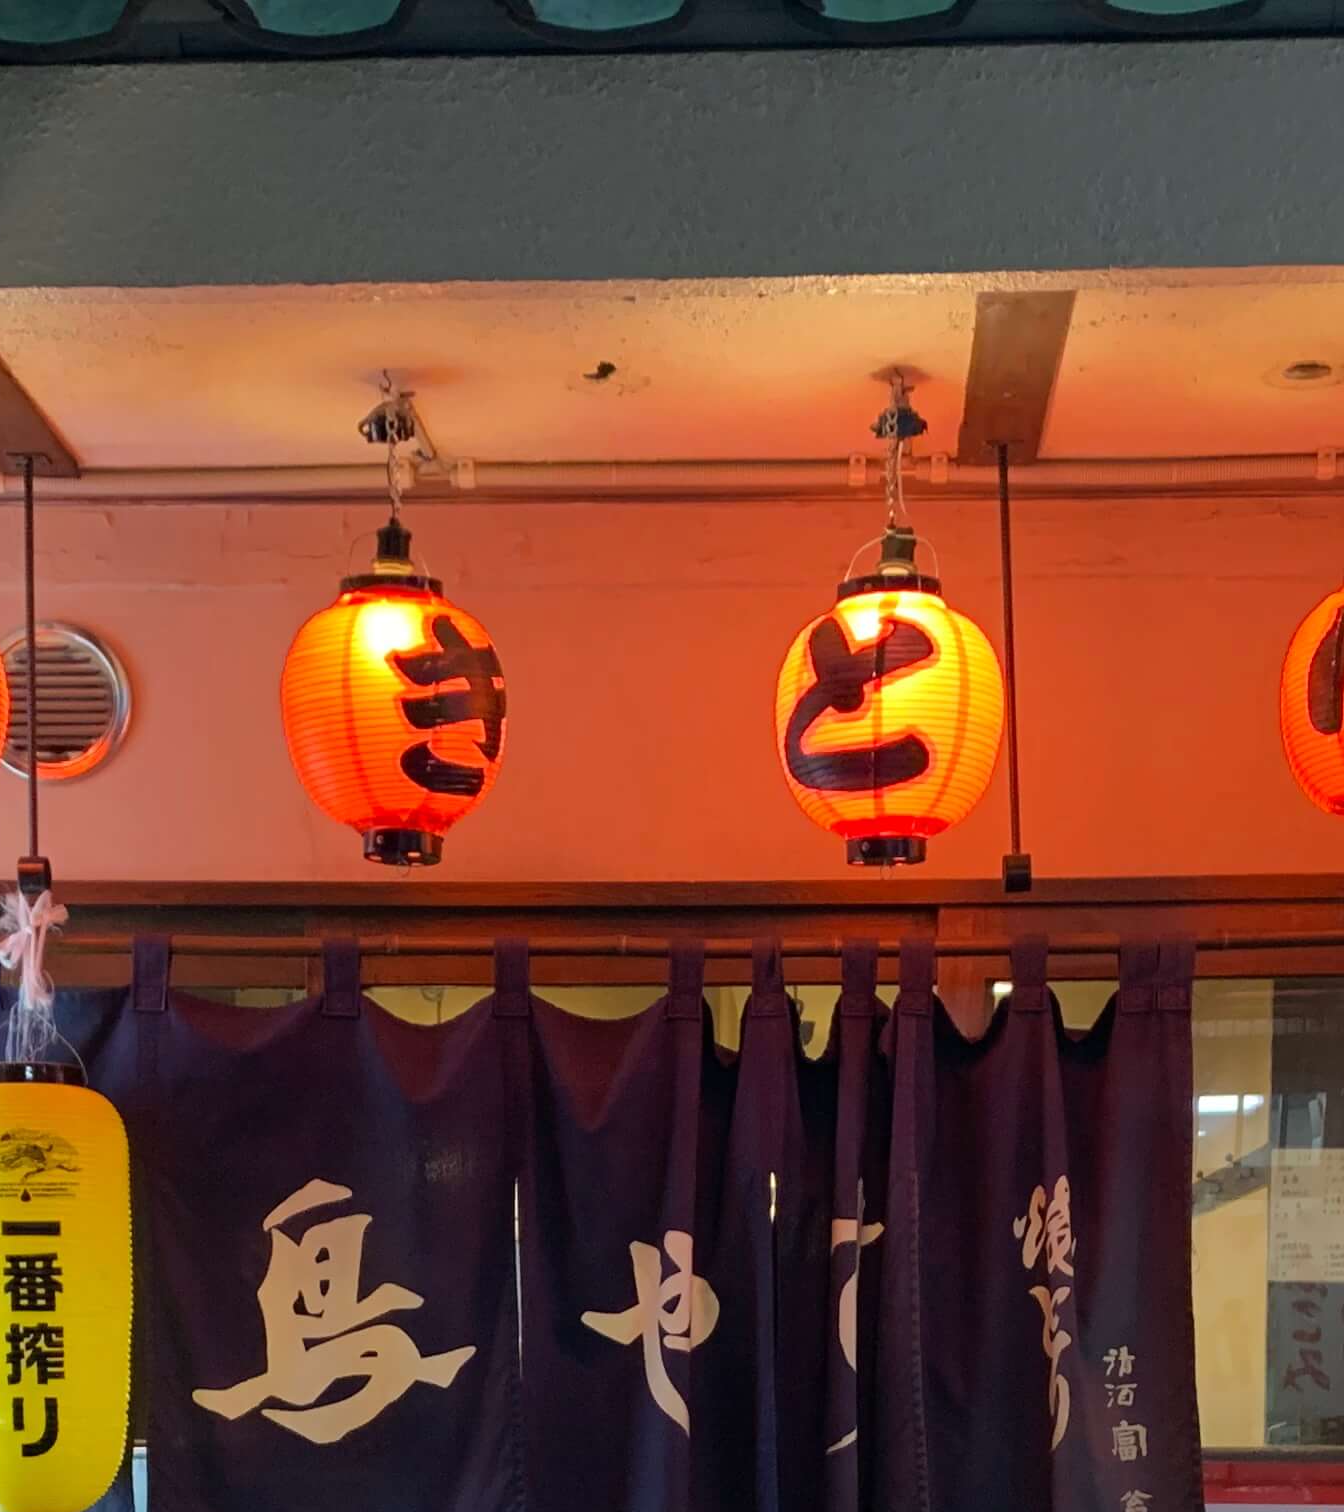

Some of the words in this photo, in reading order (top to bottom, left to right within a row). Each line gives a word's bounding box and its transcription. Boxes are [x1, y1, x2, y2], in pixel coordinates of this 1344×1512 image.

[394, 615, 507, 796] き
[784, 615, 942, 791] と
[1, 1220, 66, 1458] 一番搾り
